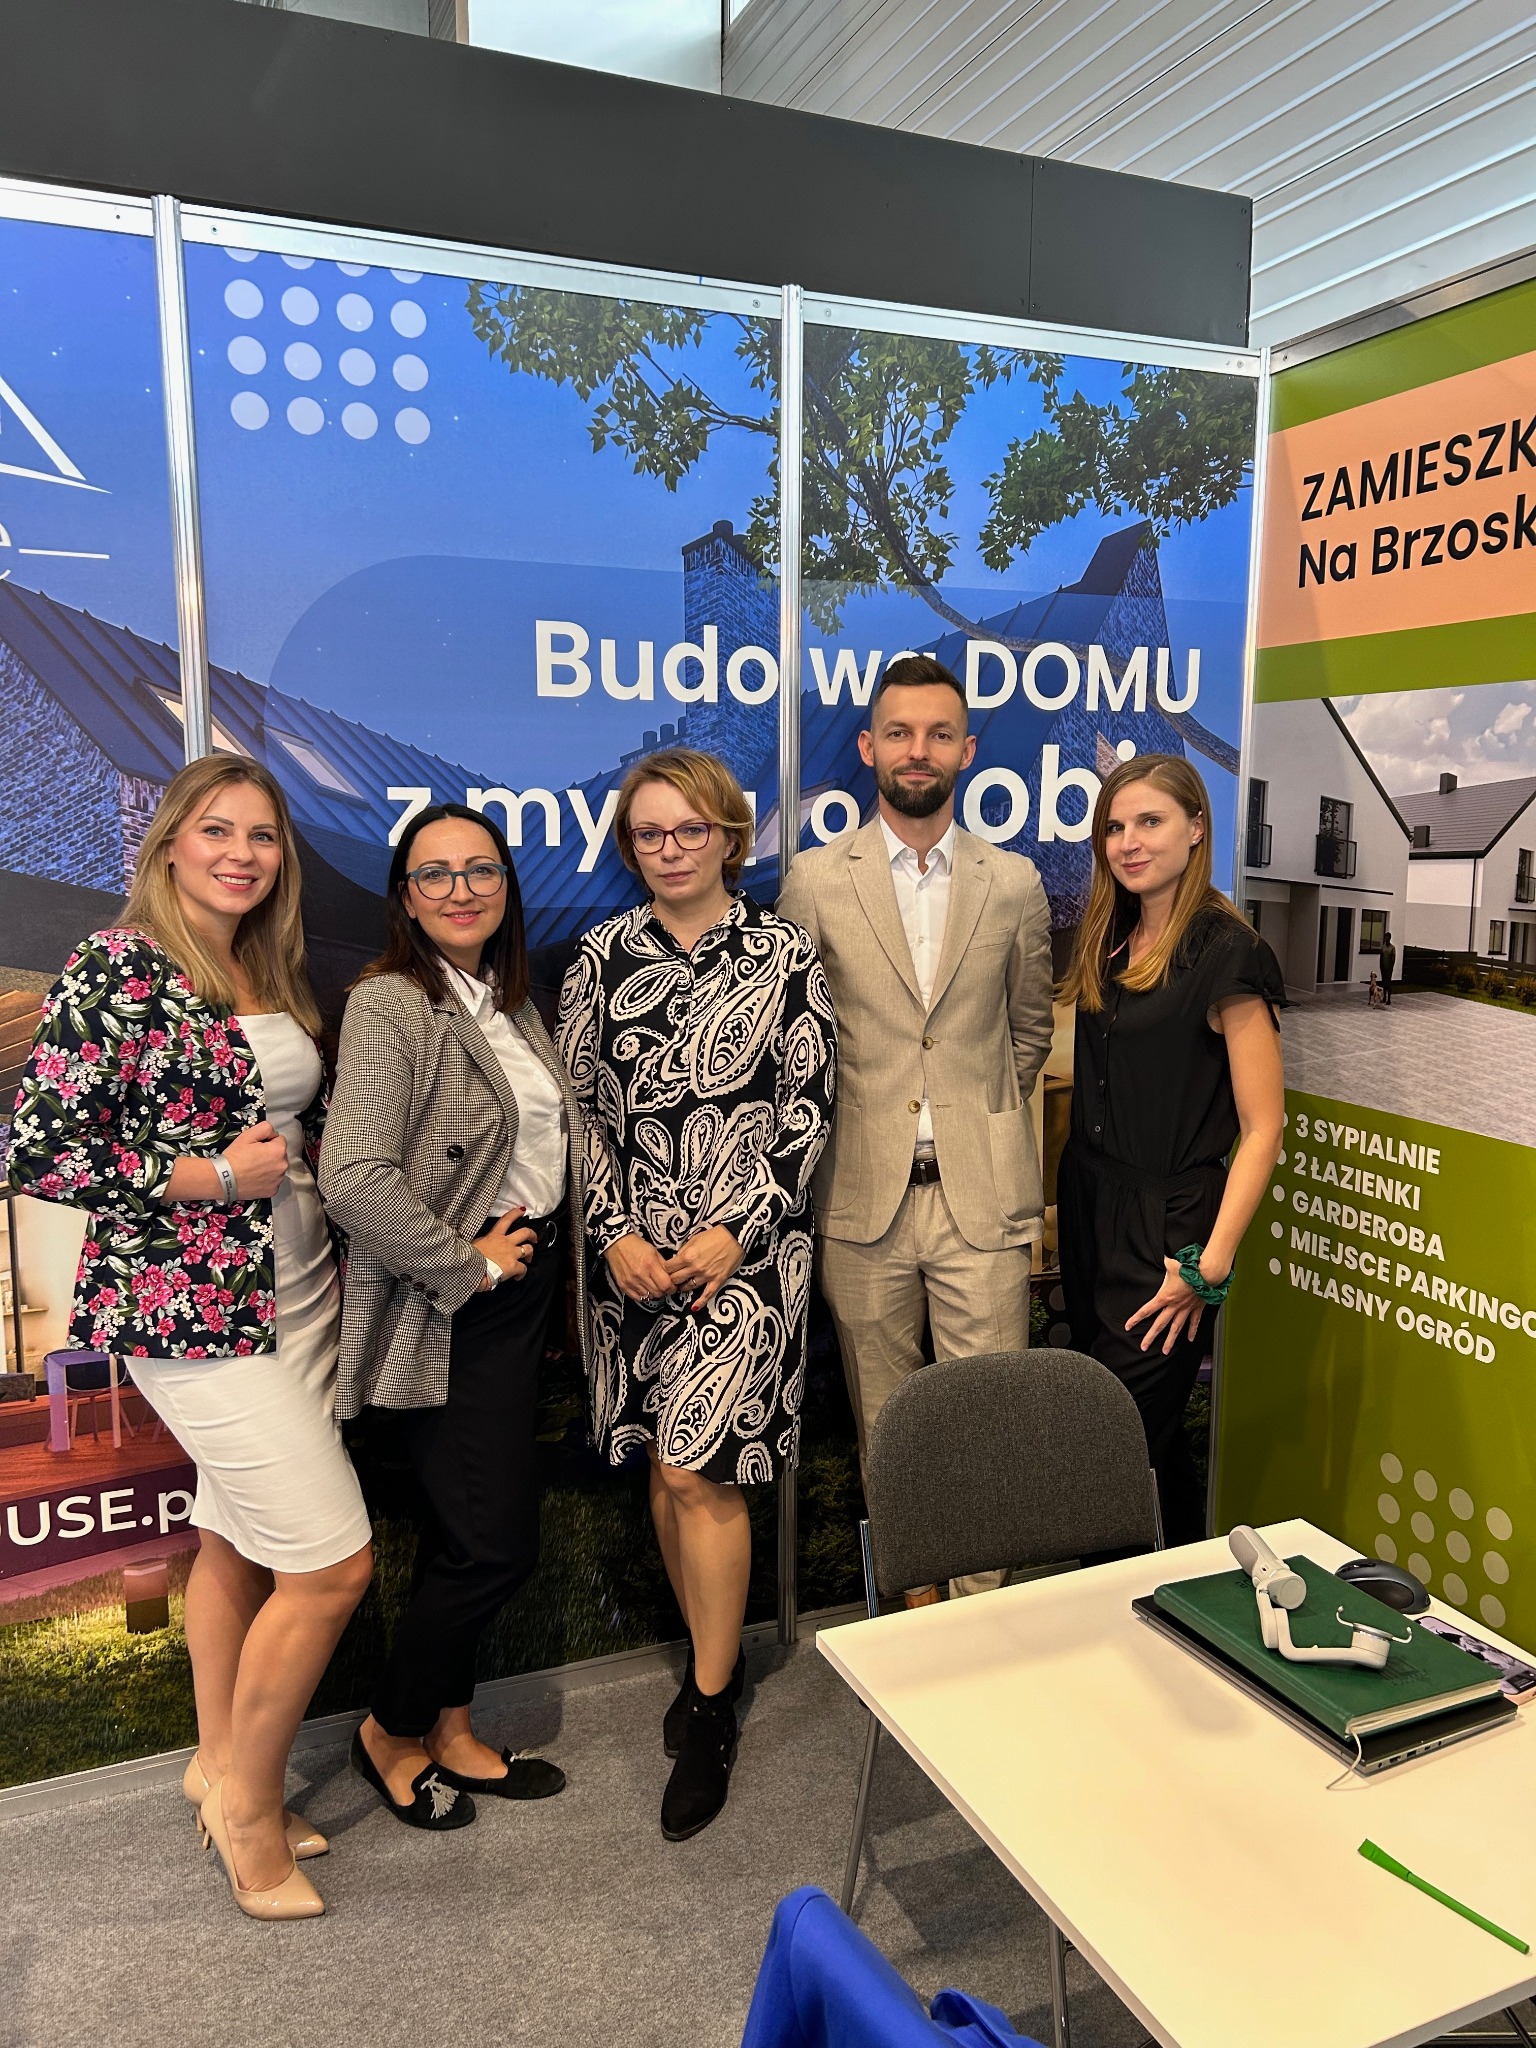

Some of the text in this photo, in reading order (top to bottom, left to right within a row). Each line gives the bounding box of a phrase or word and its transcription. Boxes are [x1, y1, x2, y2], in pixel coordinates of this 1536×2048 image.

[1299, 493, 1536, 588] Na Brzosk
[966, 639, 1201, 714] DOMU
[810, 790, 860, 843] o
[1295, 1113, 1441, 1175] 3 SYPIALNIE
[1293, 1151, 1421, 1211] 2 ŁAZIENKI
[1290, 1226, 1391, 1283] MIEJSCE
[1292, 1190, 1445, 1262] GARDEROBA
[1289, 1262, 1496, 1365] WŁASNY OGRÓD
[0, 1487, 195, 1546] USE.p
